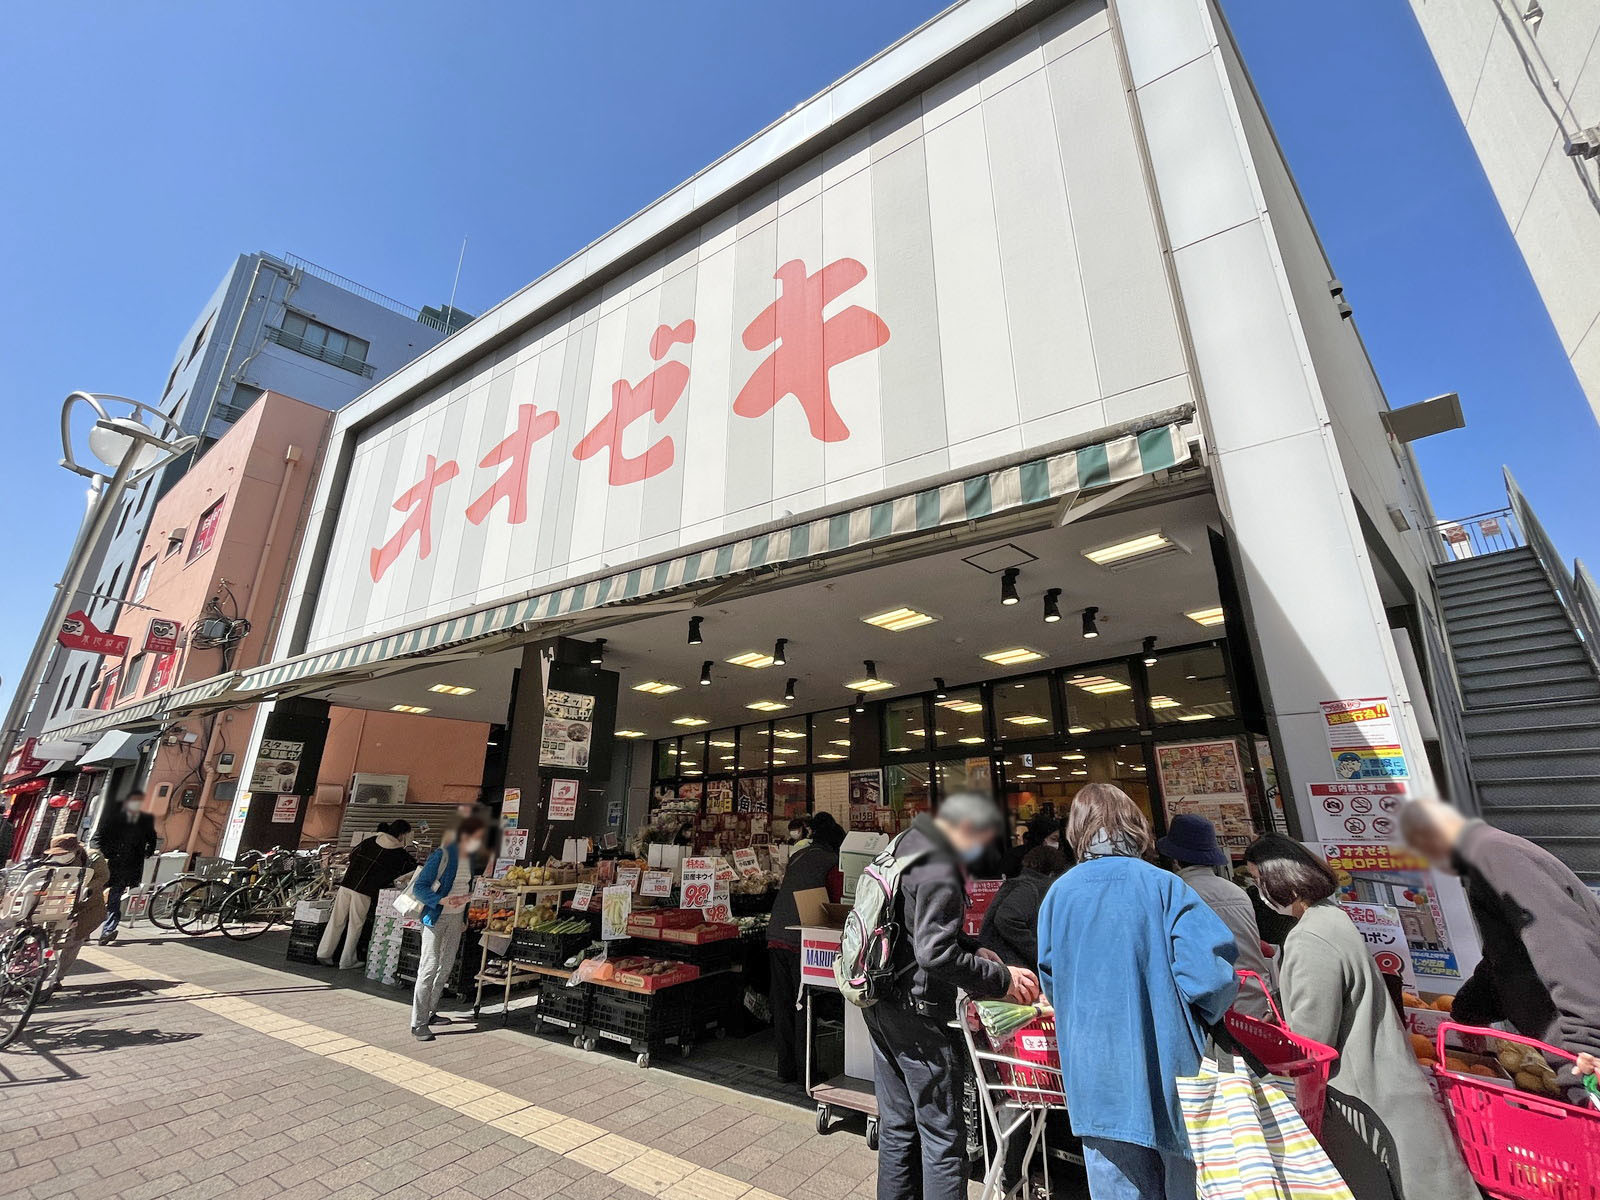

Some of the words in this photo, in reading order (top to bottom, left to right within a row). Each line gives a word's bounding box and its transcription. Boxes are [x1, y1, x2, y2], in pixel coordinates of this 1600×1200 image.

[370, 258, 890, 583] オオゼキ
[263, 740, 302, 751] スタッフ
[1328, 783, 1387, 792] 店内禁止事項
[1344, 846, 1387, 856] オオゼキ
[685, 883, 711, 907] 98
[1356, 926, 1396, 944] コポン
